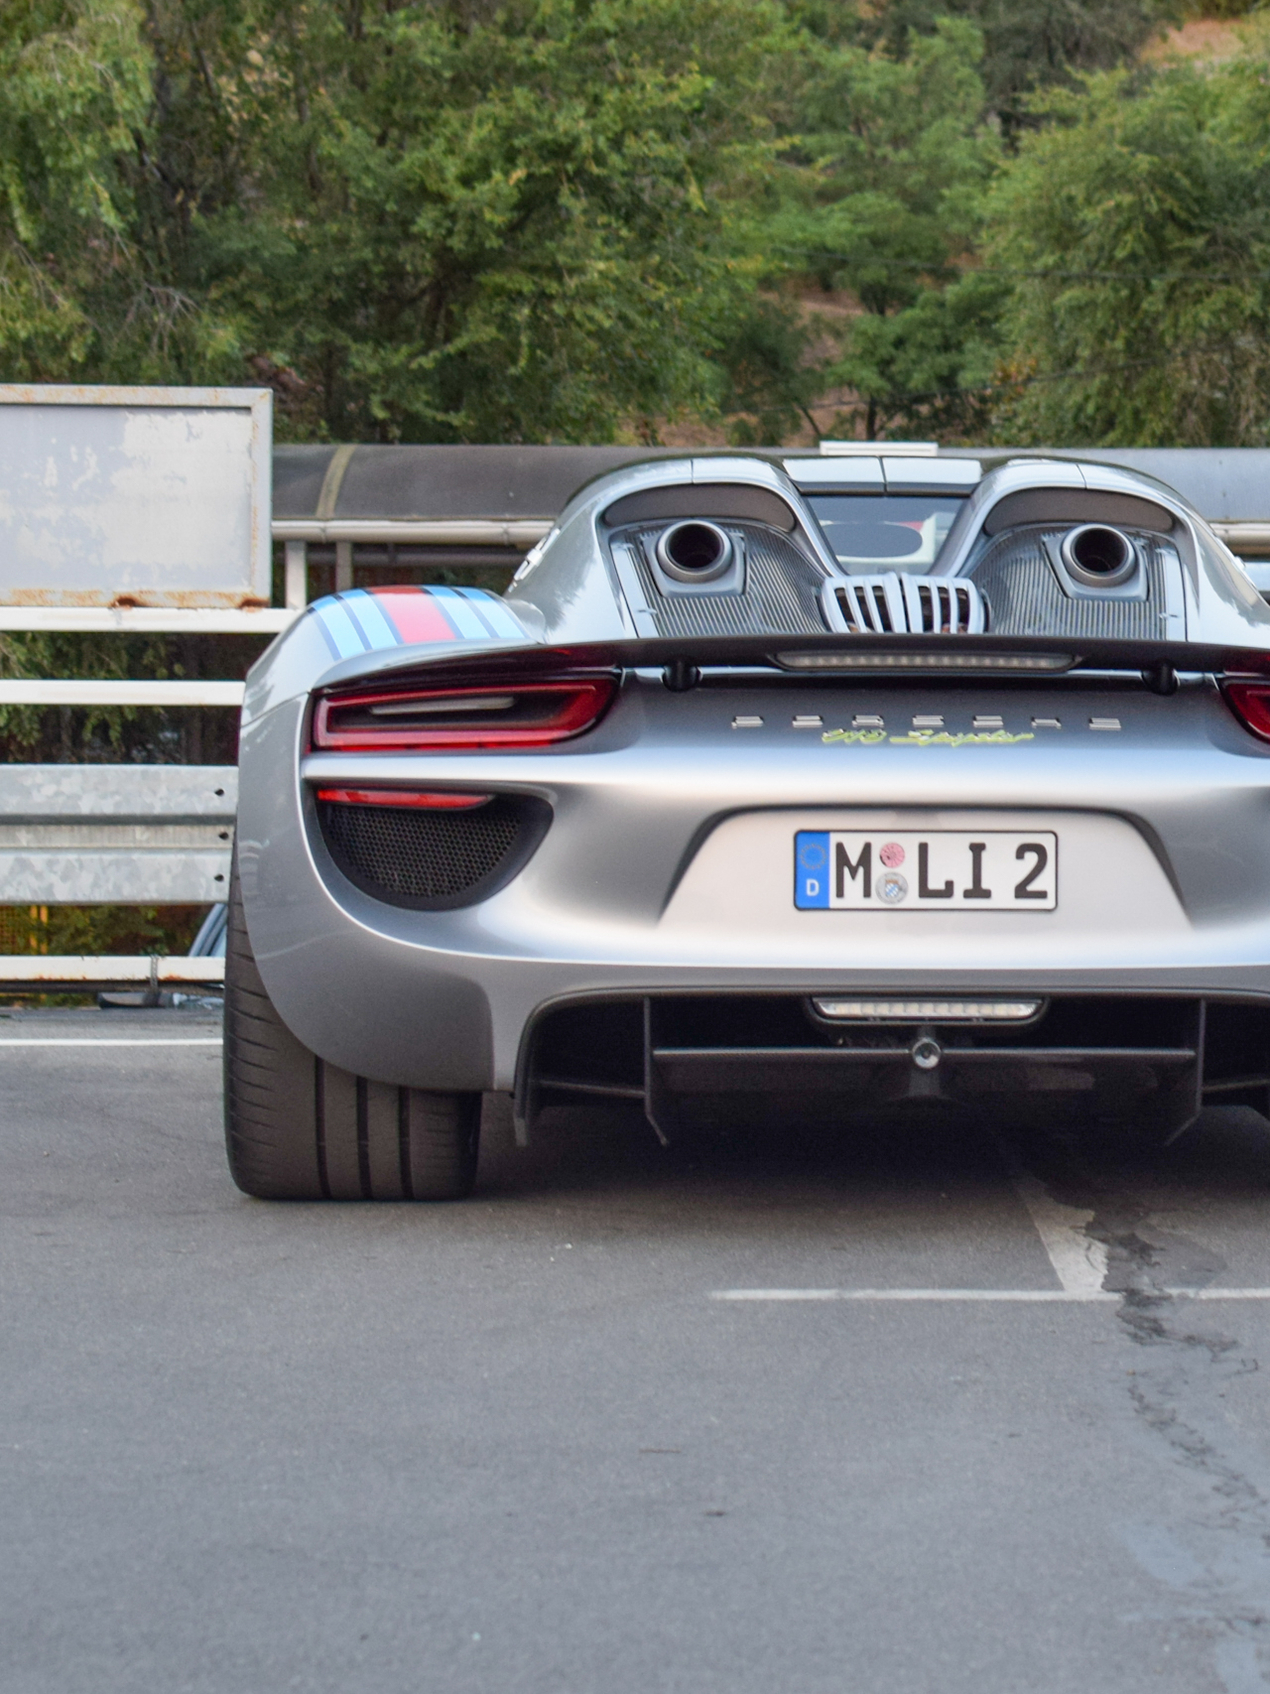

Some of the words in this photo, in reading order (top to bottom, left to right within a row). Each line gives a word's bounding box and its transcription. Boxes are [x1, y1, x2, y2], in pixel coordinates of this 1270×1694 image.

[805, 878, 820, 897] D
[835, 842, 873, 899] M
[918, 842, 992, 899] LI
[1013, 842, 1049, 899] 2
